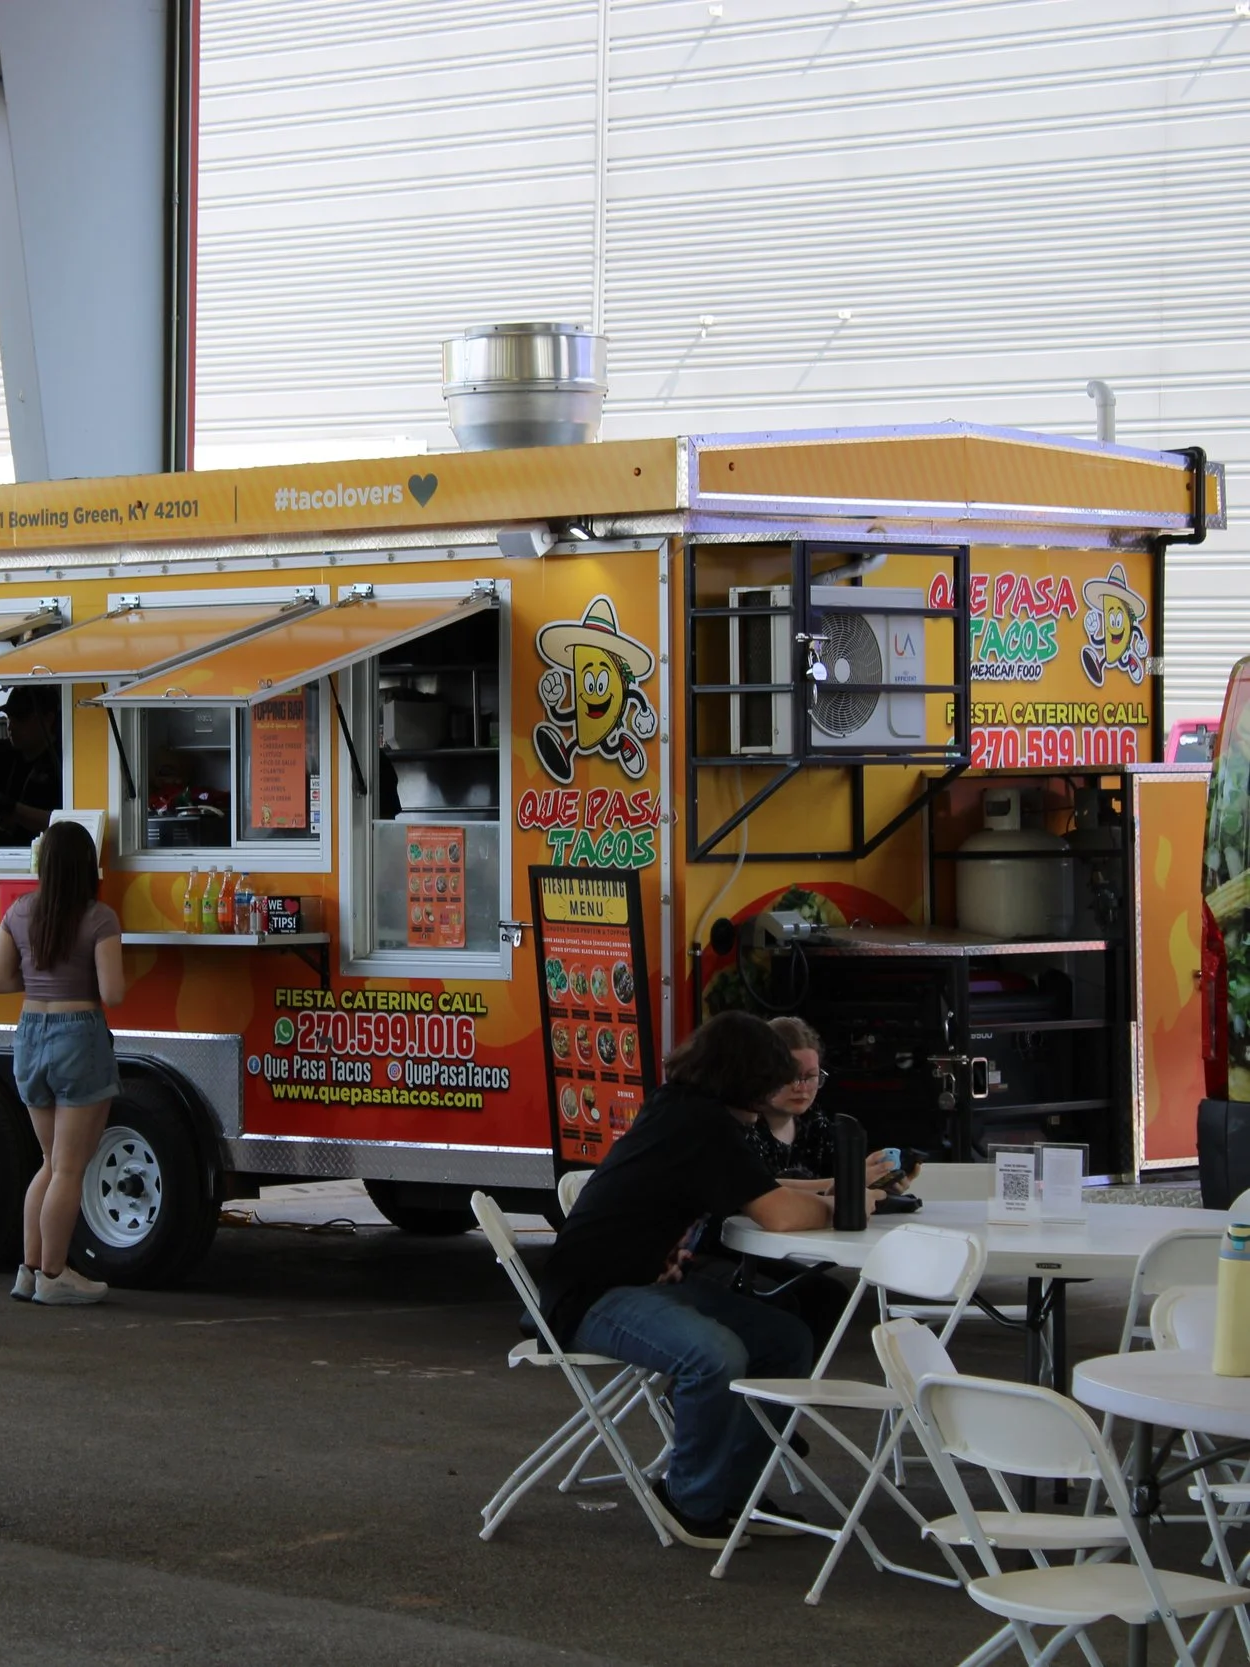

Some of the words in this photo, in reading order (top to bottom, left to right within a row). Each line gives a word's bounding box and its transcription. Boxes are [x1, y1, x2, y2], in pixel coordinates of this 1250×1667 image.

[274, 482, 404, 512] #tacolovers
[8, 506, 69, 531] Bowling
[73, 504, 123, 525] Green,
[127, 502, 150, 521] KY
[154, 499, 199, 519] 42101
[928, 571, 989, 615] QE
[993, 571, 1078, 619] PASA
[970, 663, 1016, 680] MEXICAN
[1016, 663, 1043, 679] FOOD
[288, 701, 304, 720] BAR
[946, 703, 1008, 725] FESTA
[1011, 703, 1099, 724] CATERING
[1103, 703, 1148, 725] CALL
[970, 726, 1138, 770] 270.599.1016
[518, 788, 581, 830] QUE
[547, 828, 657, 869] TACOS
[543, 878, 574, 895] FIESTA
[578, 879, 625, 898] CATERING
[268, 899, 282, 911] WE
[570, 900, 604, 917] MENU
[272, 917, 296, 928] TIPS!
[275, 989, 336, 1008] FIESTA
[340, 991, 434, 1012] CATERING
[438, 993, 488, 1013] CALL
[298, 1011, 475, 1059] 270.599.1016
[264, 1054, 289, 1080] Que
[293, 1057, 326, 1081] Pasa
[330, 1057, 372, 1083] Tacos
[405, 1059, 510, 1089] QuePasaTacos
[272, 1083, 484, 1109] www.quepasatacos.com
